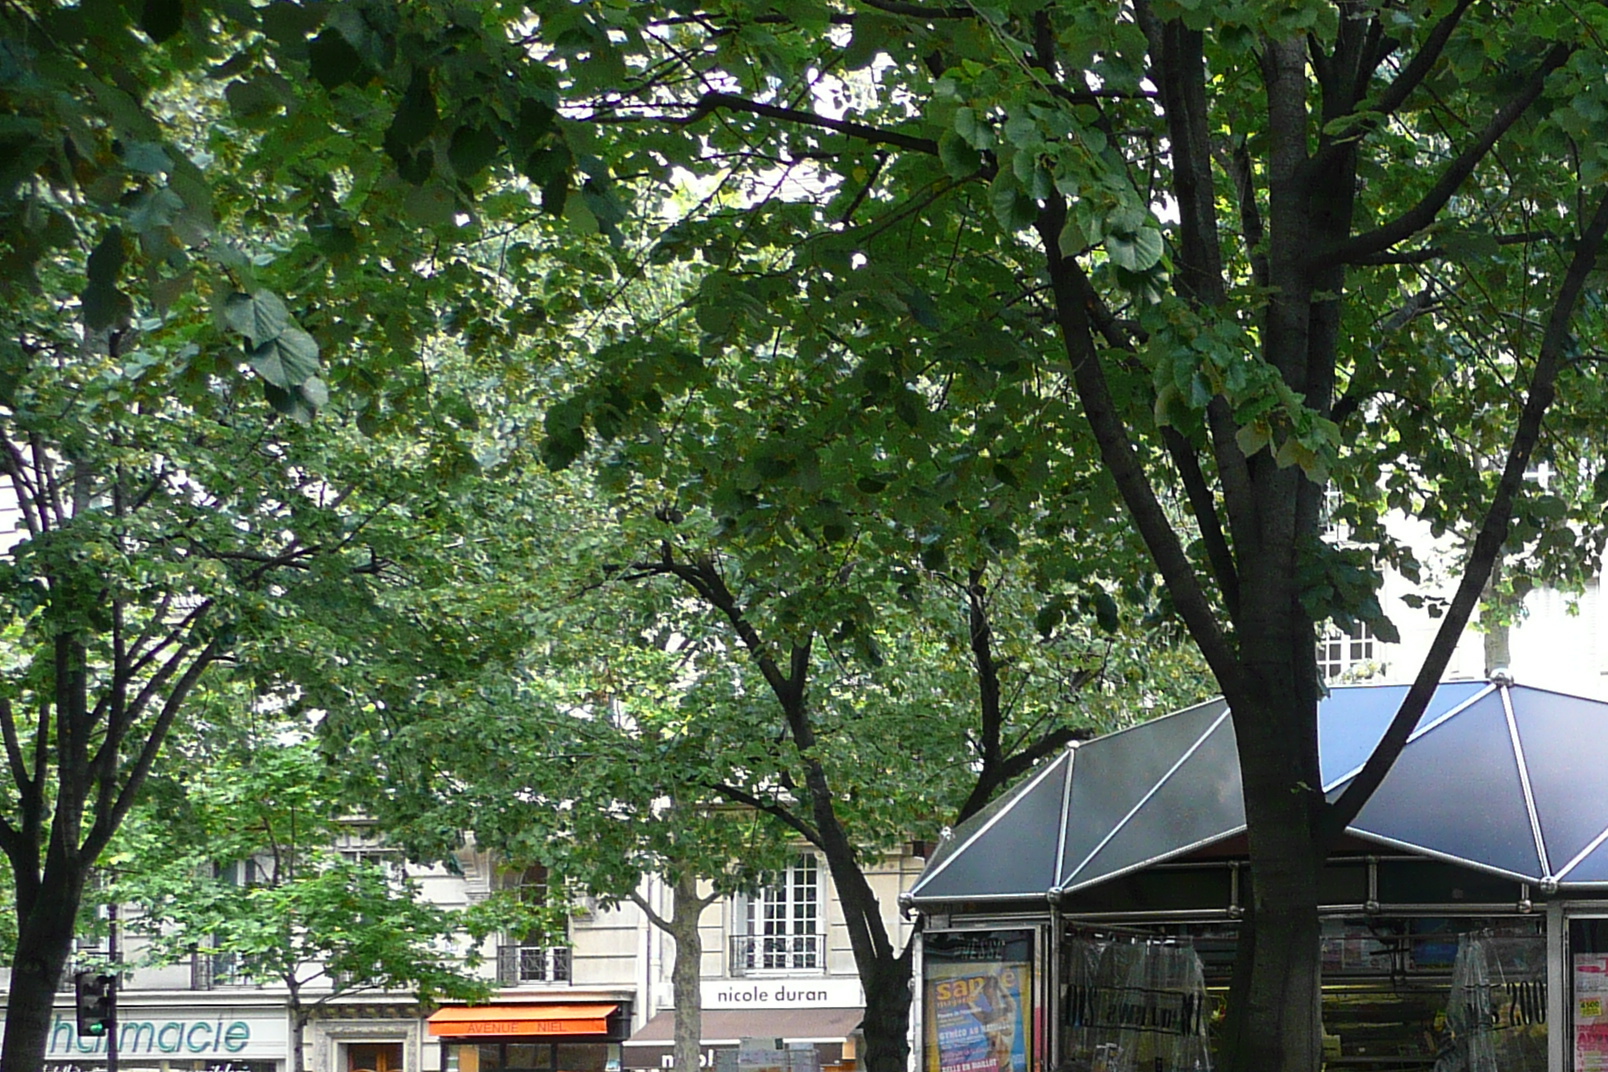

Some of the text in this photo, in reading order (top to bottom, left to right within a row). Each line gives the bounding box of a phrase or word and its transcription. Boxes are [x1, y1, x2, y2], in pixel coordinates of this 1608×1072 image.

[936, 966, 1016, 1001] sané
[718, 986, 827, 1002] nicole duran
[467, 1021, 567, 1034] AVENUE NIEL
